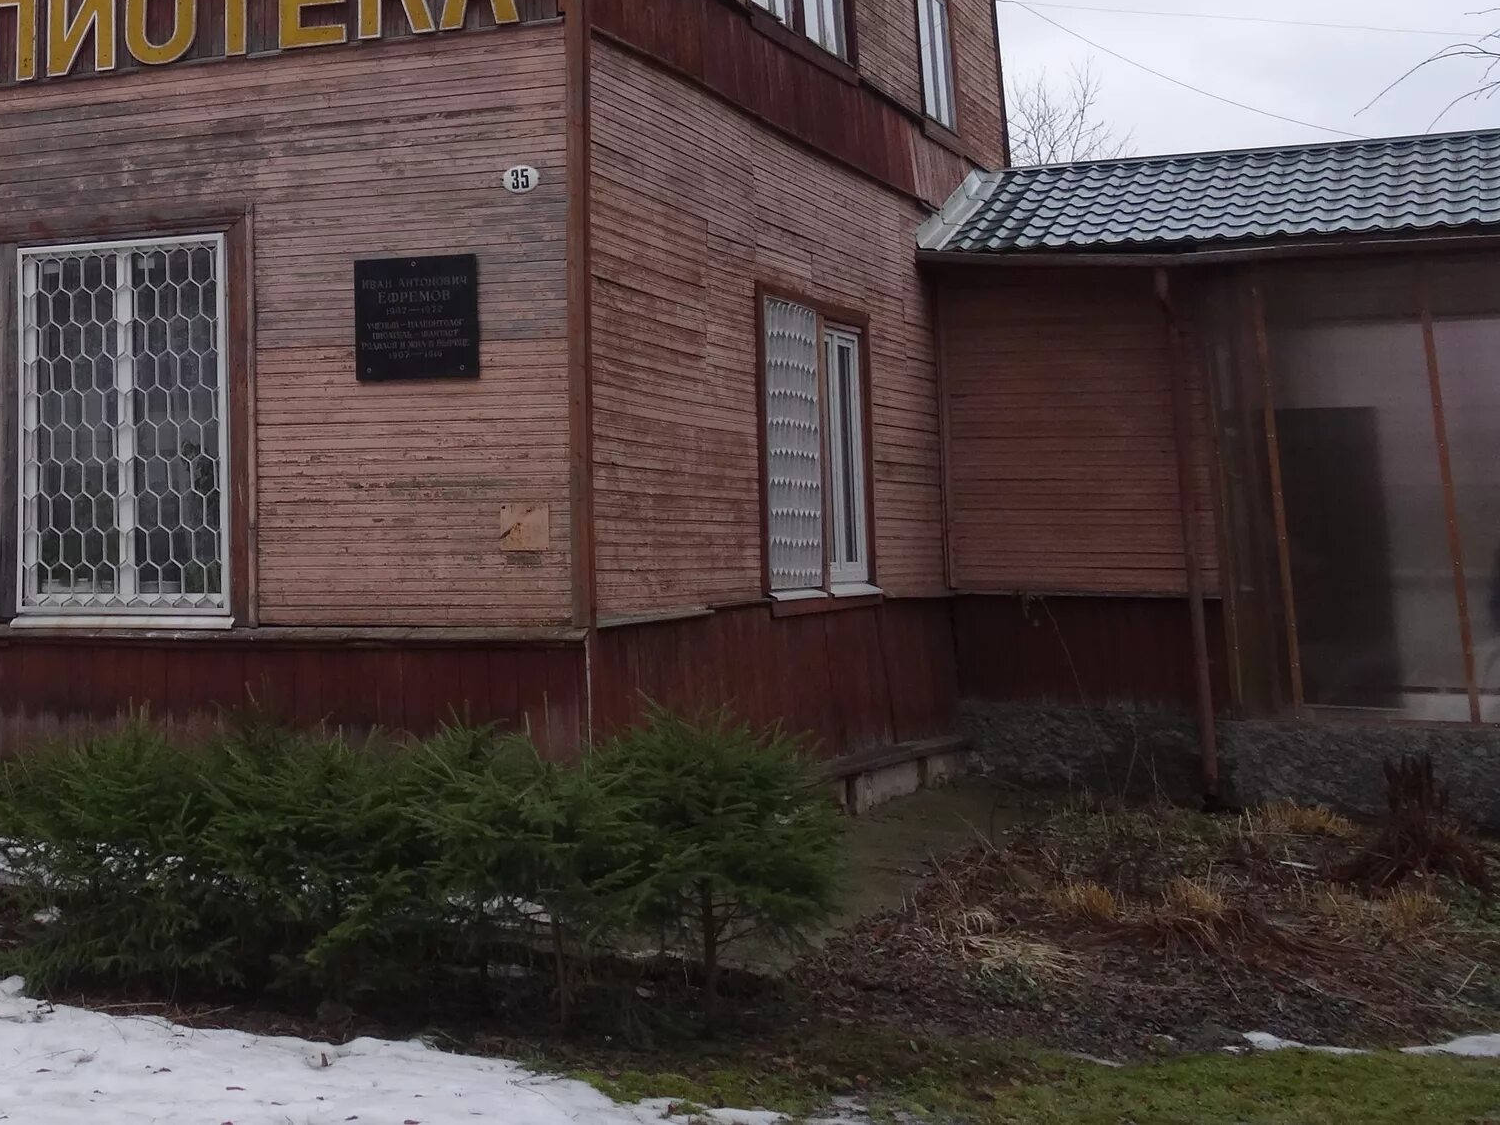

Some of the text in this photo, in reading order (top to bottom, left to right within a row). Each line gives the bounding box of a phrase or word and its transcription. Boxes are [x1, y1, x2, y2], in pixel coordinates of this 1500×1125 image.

[511, 168, 530, 190] 35
[362, 275, 468, 290] ИВАН АНТОНОВИЧ
[378, 290, 451, 304] ЕФРЕМОВ
